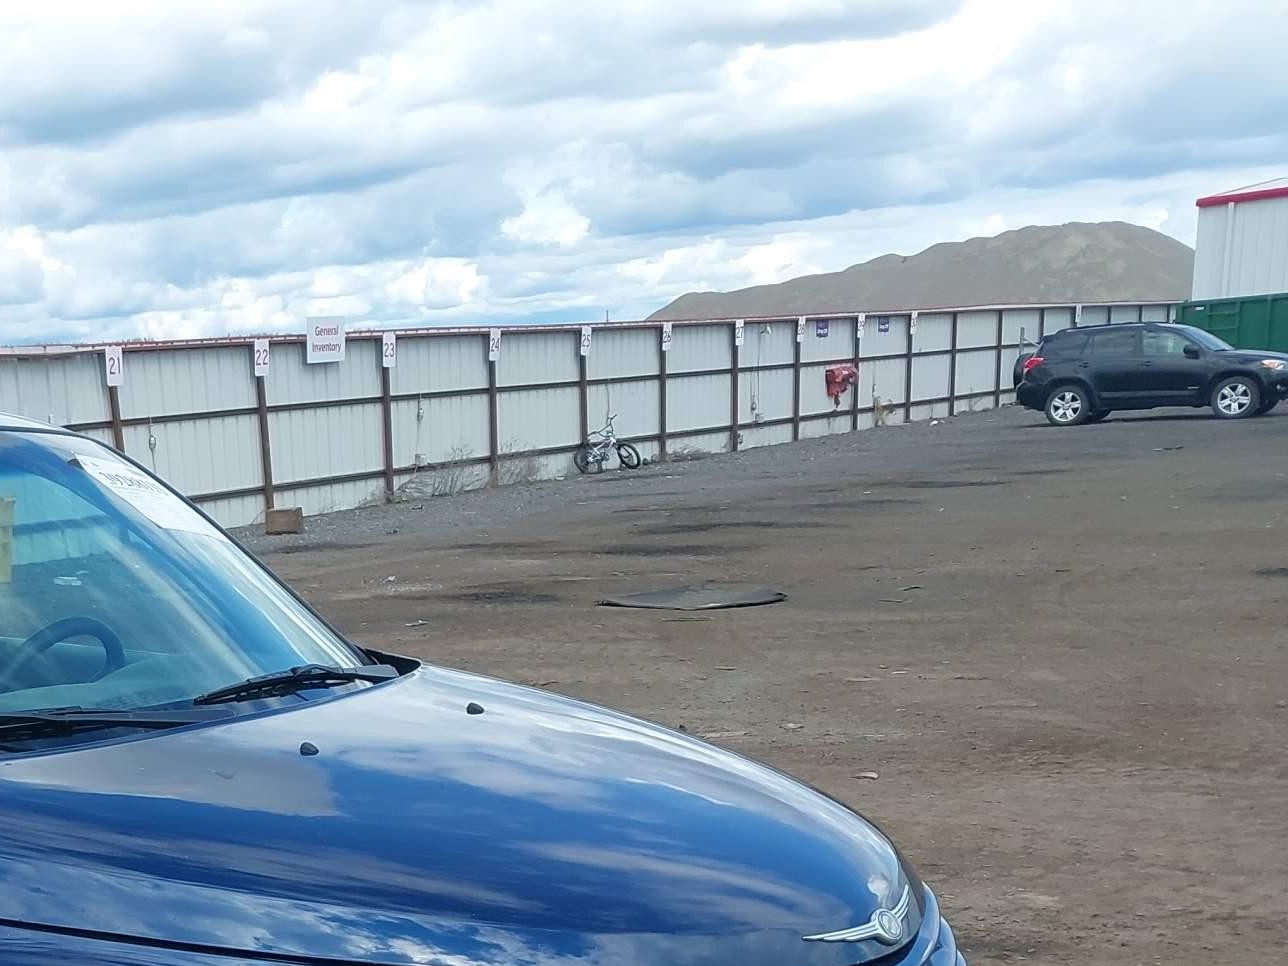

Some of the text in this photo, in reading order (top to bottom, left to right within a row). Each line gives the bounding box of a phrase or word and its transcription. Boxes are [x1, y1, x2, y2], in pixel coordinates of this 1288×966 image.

[314, 325, 339, 337] General
[663, 330, 672, 343] 26
[735, 326, 744, 339] 27
[312, 342, 342, 352] Inventory
[491, 337, 501, 352] 24
[582, 333, 591, 348] 25
[255, 349, 268, 366] 22
[384, 342, 395, 358] 23
[108, 356, 121, 375] 21
